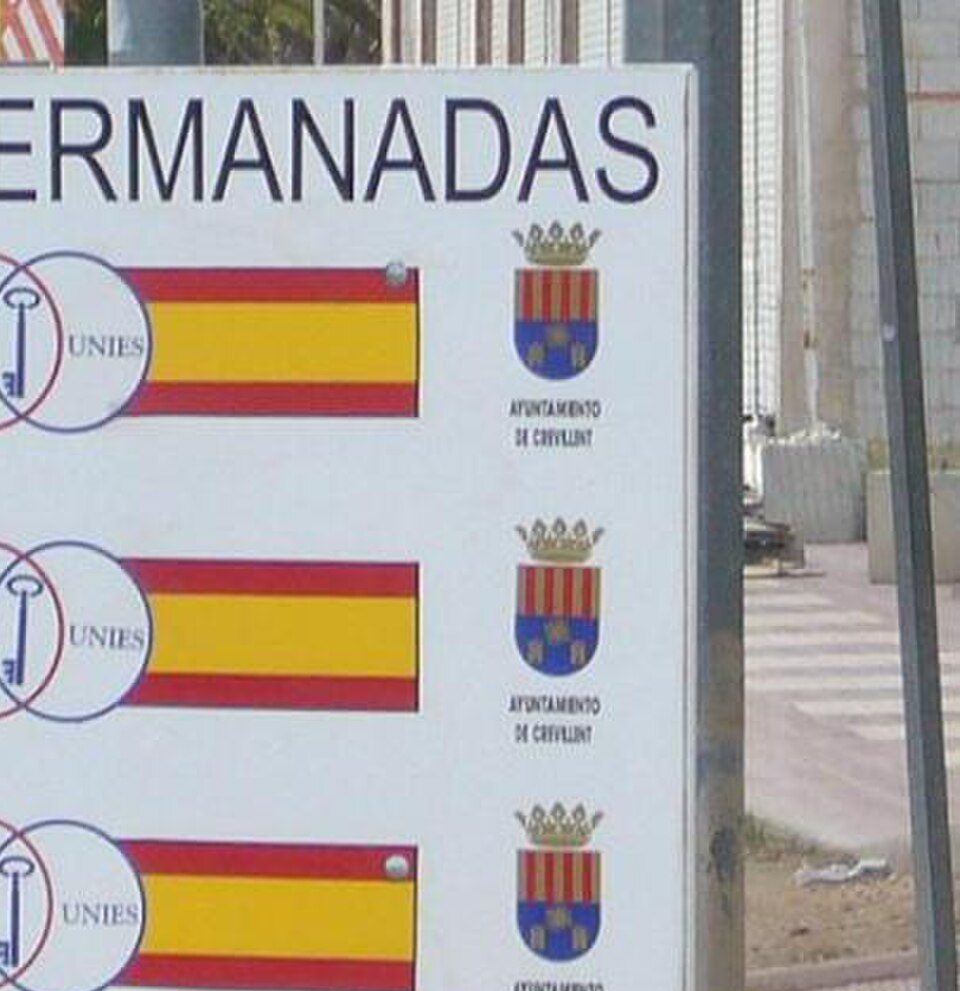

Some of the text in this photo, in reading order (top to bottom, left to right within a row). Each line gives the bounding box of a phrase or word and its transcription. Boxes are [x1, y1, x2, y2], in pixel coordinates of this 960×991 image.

[68, 334, 145, 358] UNIES
[69, 625, 146, 650] UNIES
[62, 903, 140, 926] UNIES
